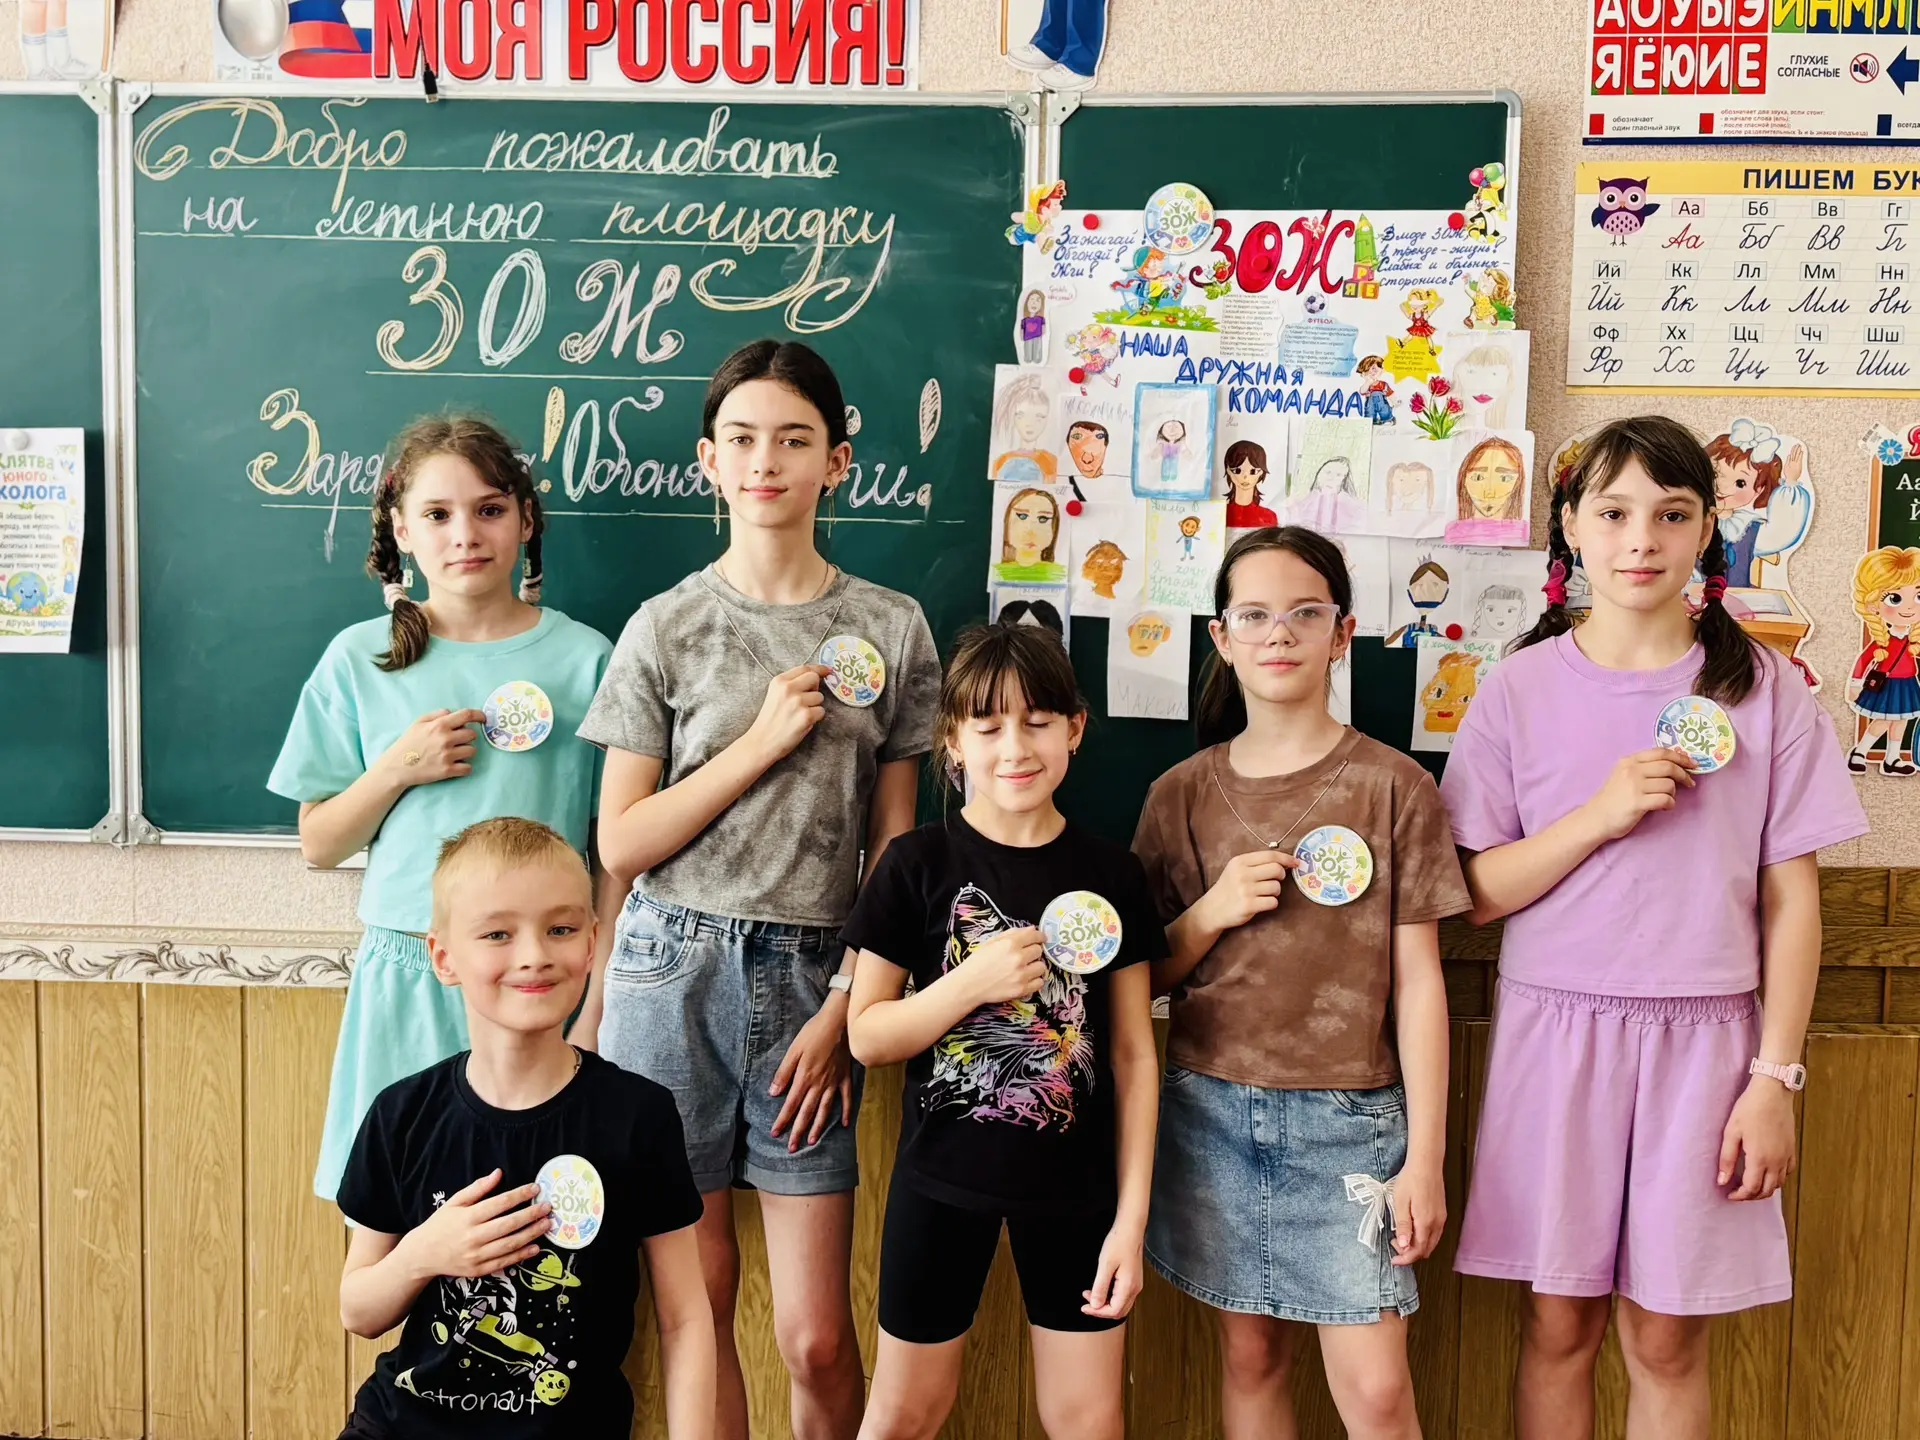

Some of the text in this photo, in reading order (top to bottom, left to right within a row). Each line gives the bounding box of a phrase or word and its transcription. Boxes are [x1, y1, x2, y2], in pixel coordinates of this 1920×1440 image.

[372, 0, 905, 85] МОЯ РОССИЯ!
[1790, 55, 1829, 65] ГЛУХИЕ
[1777, 67, 1841, 78] СОГЛАСНЫЕ
[134, 97, 839, 214] Добро пожаловать
[1743, 169, 1854, 190] ПИШЕМ
[1159, 211, 1199, 231] ЗОЖ
[1678, 202, 1902, 217] Аа Бб Вв Гг
[1661, 222, 1705, 249] Аа
[1739, 223, 1785, 249] Бб
[1807, 224, 1845, 251] Вв
[1188, 210, 1356, 296] ЗОЖ
[1380, 244, 1388, 257] в
[1392, 246, 1437, 262] тренде
[1449, 236, 1508, 259] жизнь!
[183, 196, 896, 334] на летнюю площадку
[1051, 260, 1100, 279] Жги!
[1377, 257, 1423, 273] Слабых
[1428, 262, 1438, 270] и
[1597, 262, 1904, 280] Йй Кк Лл Мм Нн
[1379, 270, 1463, 291] сторонись!
[1587, 281, 1912, 314] Йй Кк Лл Мм Нн
[1307, 317, 1334, 325] ФУТБОЛ
[1119, 330, 1189, 358] НАША
[1593, 325, 1900, 343] Фф Хх Цц Чч Шш
[1174, 357, 1305, 387] ДРУЖНАЯ
[1583, 345, 1911, 383] Фф Хх Цц Чч Шш
[1227, 387, 1364, 418] КОМАНДА
[3, 471, 48, 483] юного
[0, 484, 67, 500] колога
[833, 658, 869, 687] ЗОЖ
[498, 708, 539, 729] ЗОЖ
[1673, 718, 1716, 756] ЗОЖ
[1312, 847, 1352, 887] ЗОЖ
[1059, 922, 1105, 946] ЗОЖ
[551, 1194, 591, 1215] ЗОЖ
[394, 1366, 541, 1416] Astronaut
